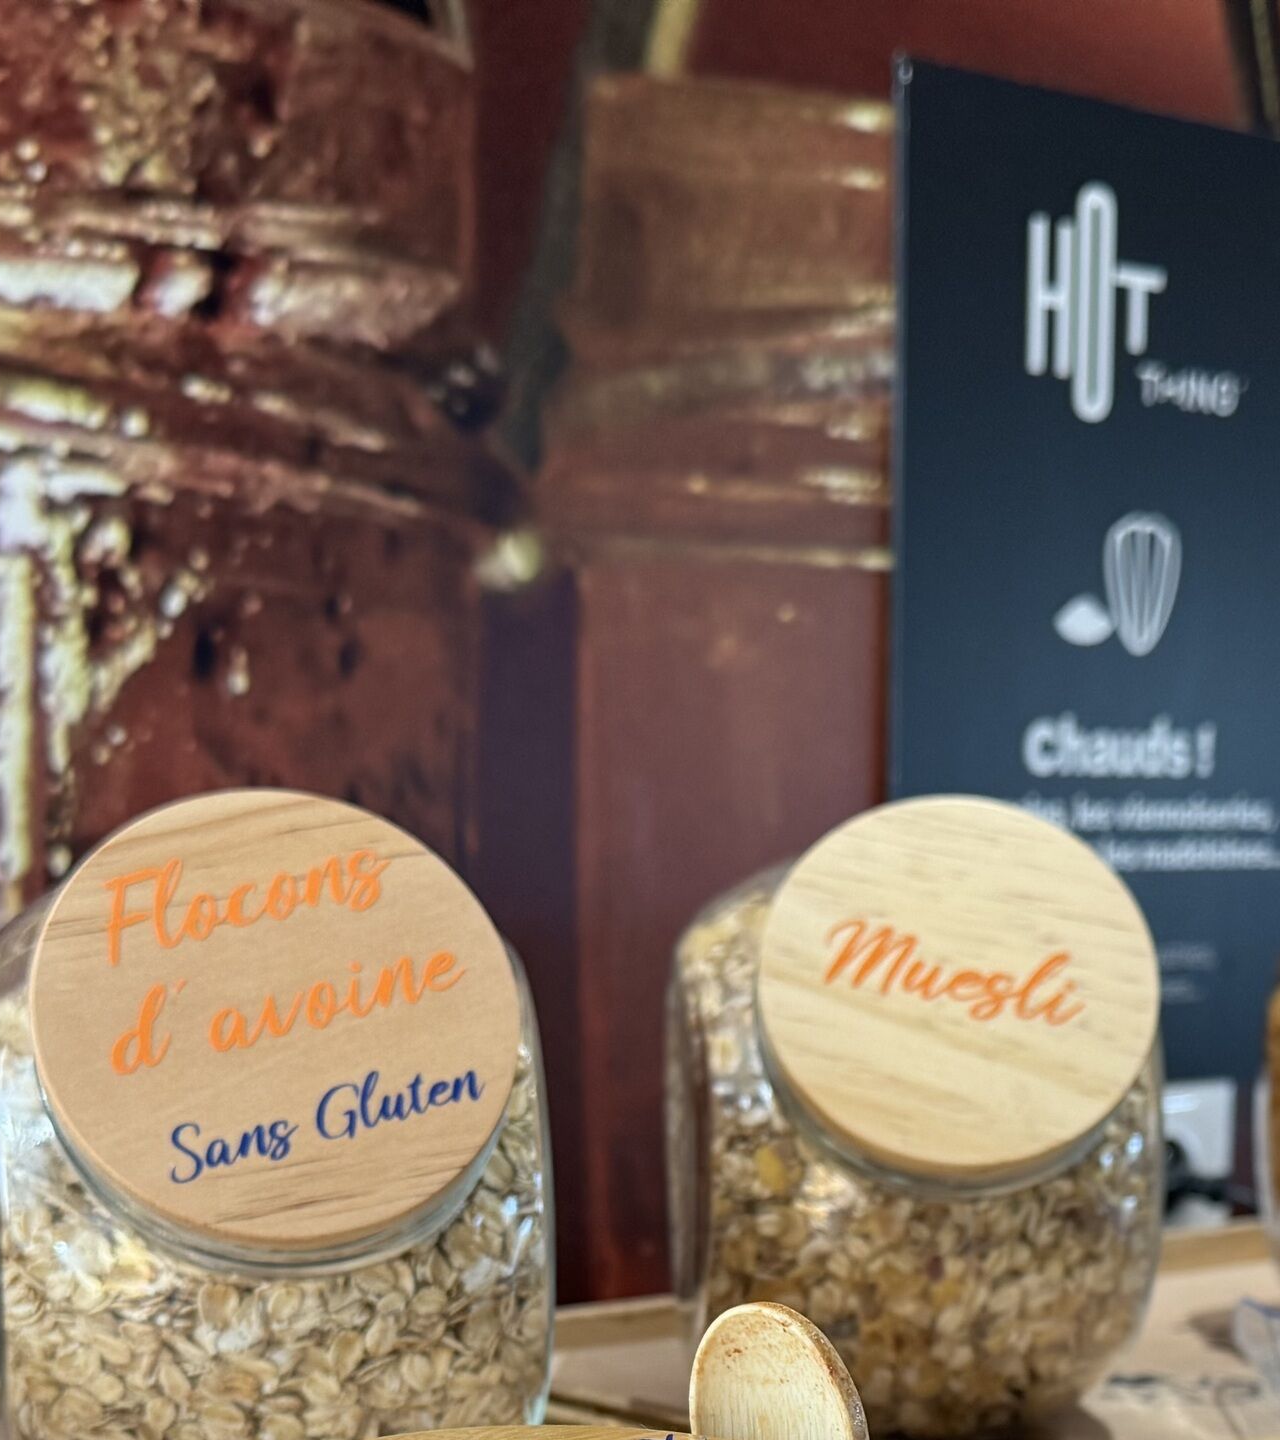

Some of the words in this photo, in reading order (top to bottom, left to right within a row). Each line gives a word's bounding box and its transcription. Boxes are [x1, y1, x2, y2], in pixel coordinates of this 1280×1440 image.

[1025, 180, 1169, 424] HOT
[103, 849, 391, 966] Flocons
[824, 914, 1086, 1026] Muesli
[169, 1120, 298, 1184] Sans
[315, 1069, 486, 1141] Gluten
